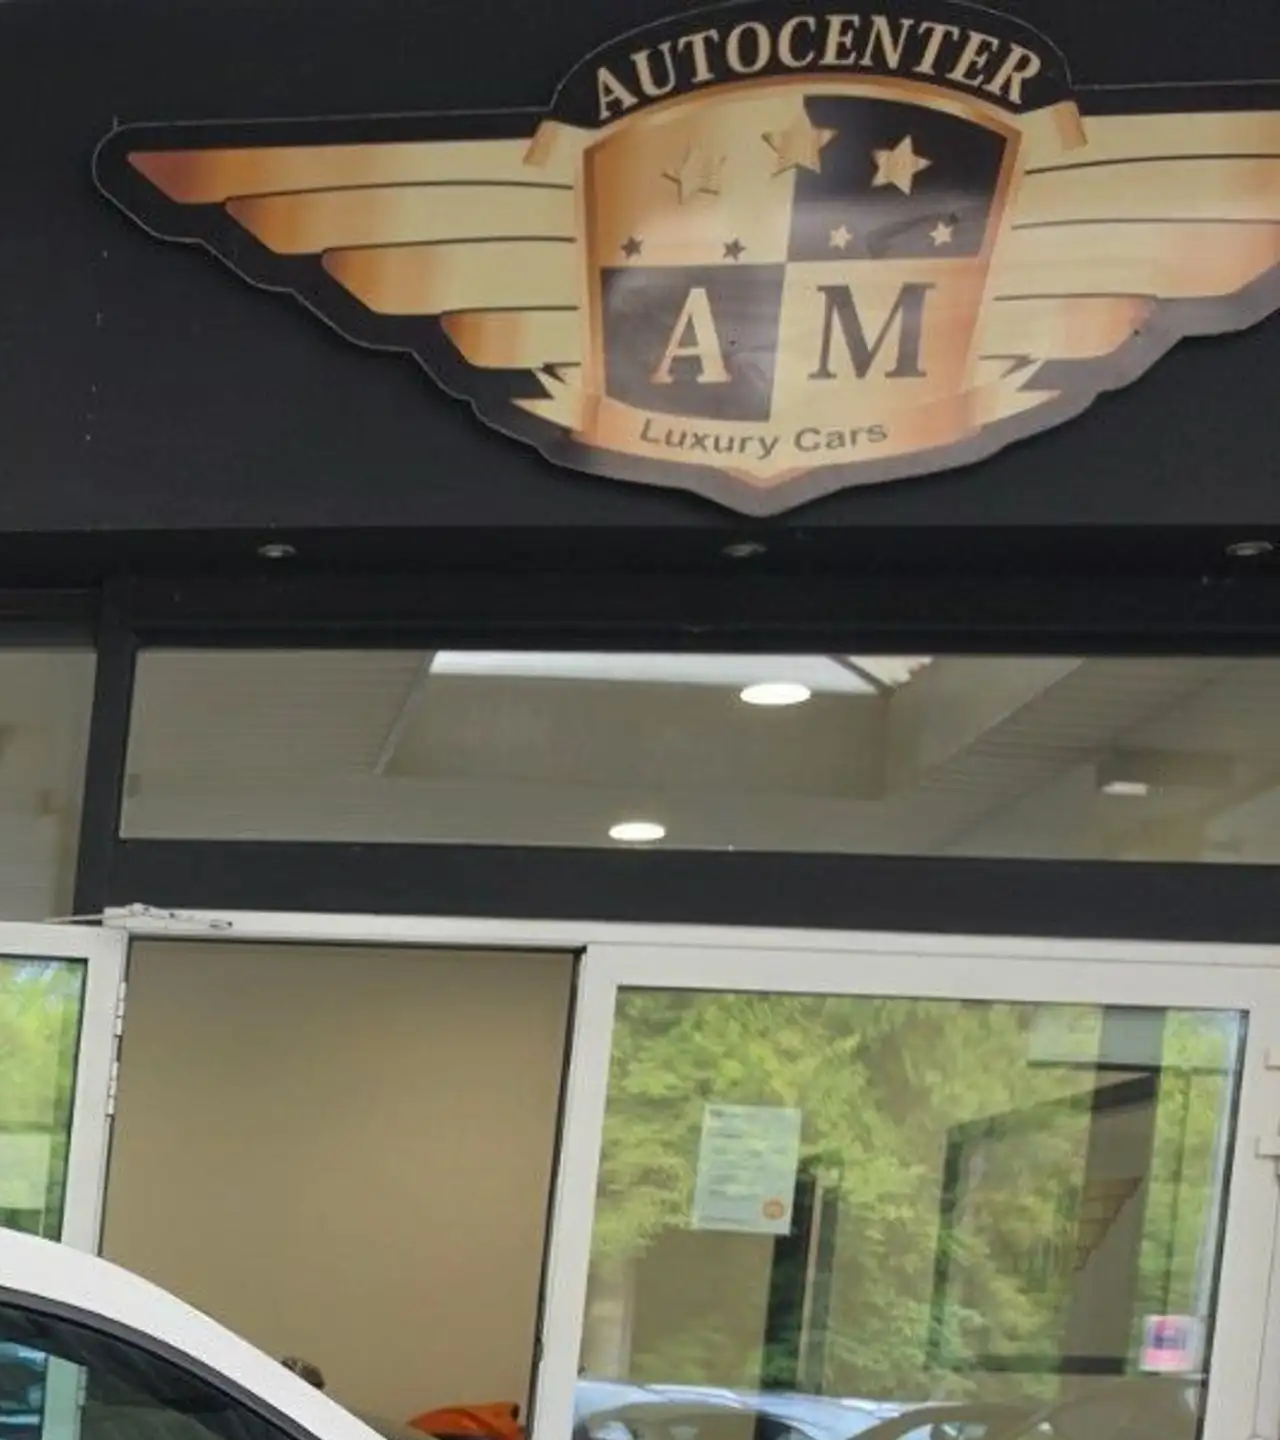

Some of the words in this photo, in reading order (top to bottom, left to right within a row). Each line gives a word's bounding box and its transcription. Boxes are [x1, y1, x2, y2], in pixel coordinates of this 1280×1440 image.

[596, 14, 1041, 121] AUTOCENTER
[649, 287, 732, 384] A
[807, 281, 937, 380] M
[639, 417, 780, 460] Luxury
[793, 423, 889, 453] Cars
